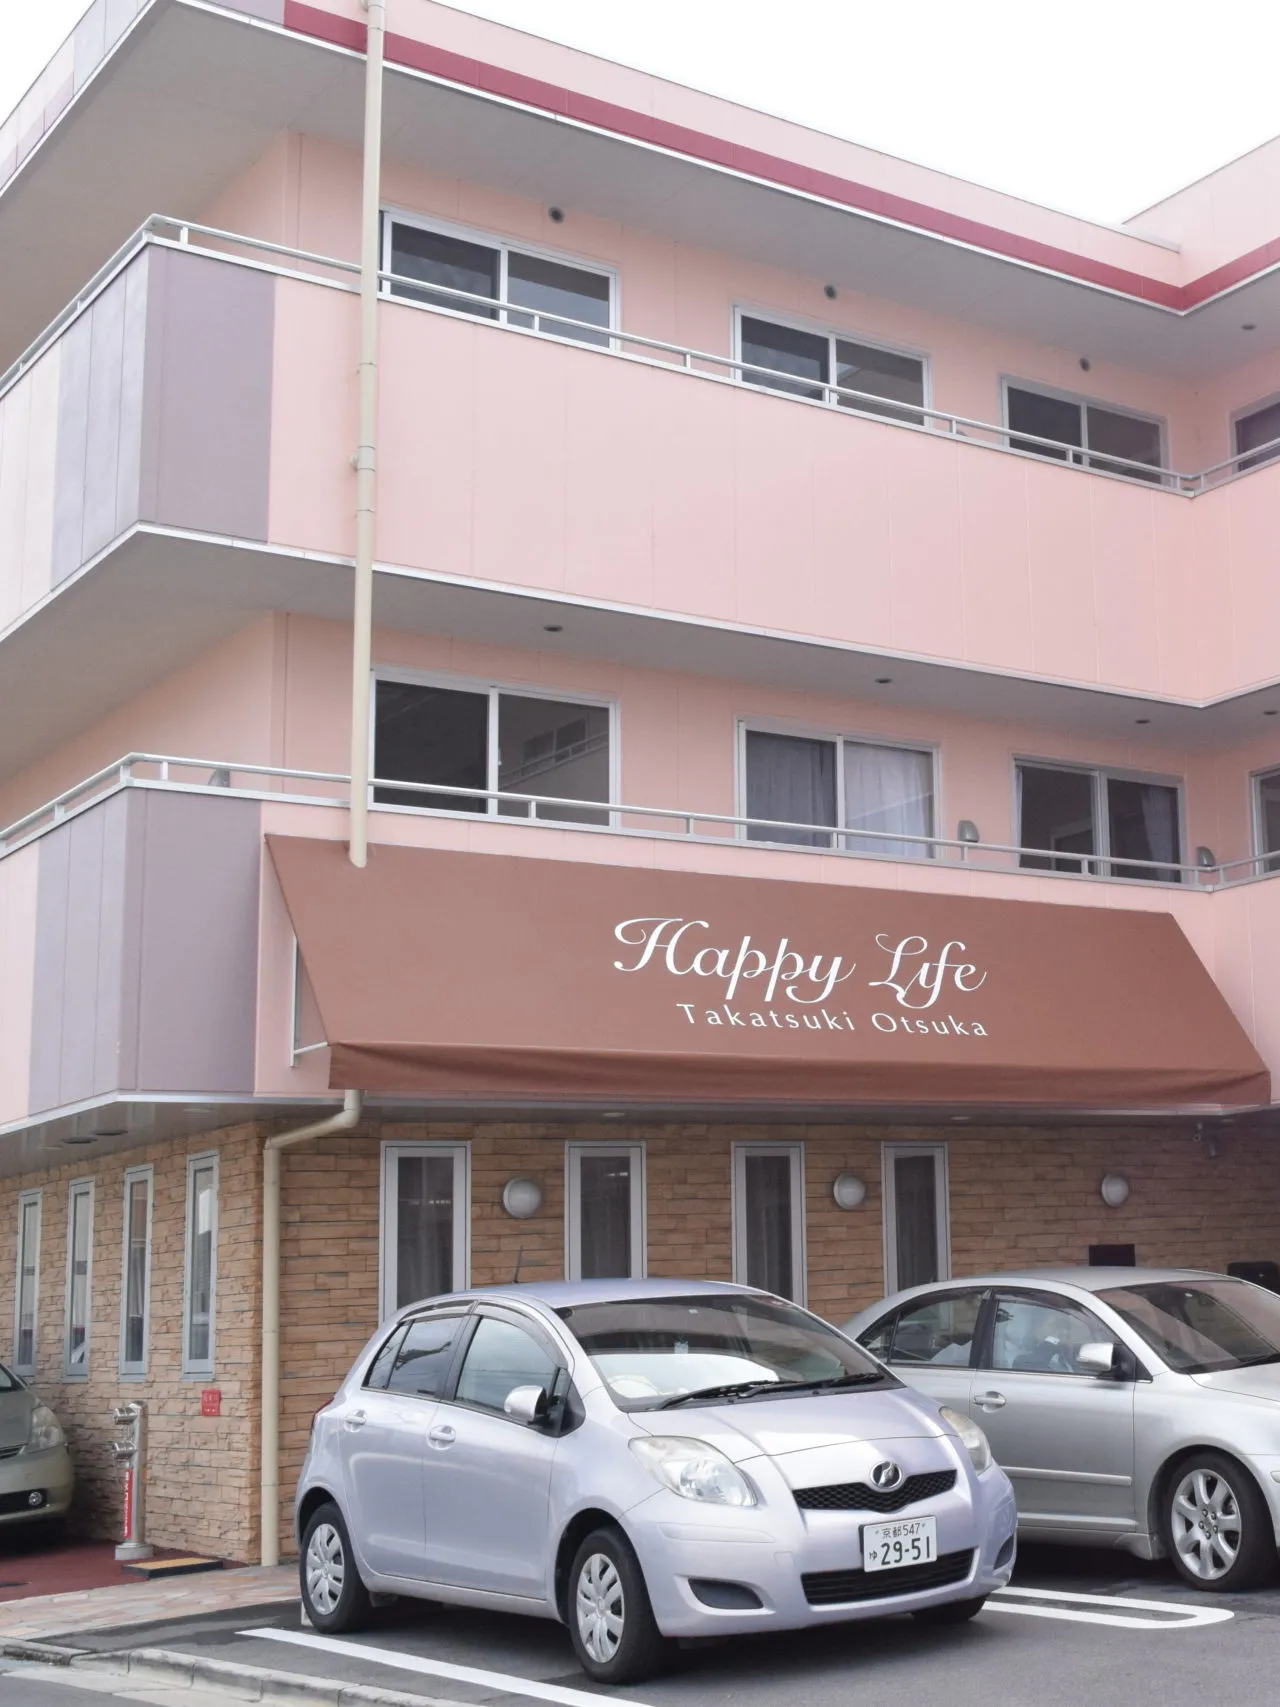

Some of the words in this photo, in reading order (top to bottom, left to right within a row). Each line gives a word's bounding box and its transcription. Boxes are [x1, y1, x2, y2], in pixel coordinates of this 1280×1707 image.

[613, 918, 856, 1004] Happy
[868, 933, 988, 1009] Life
[676, 1003, 855, 1031] Takatsuki
[871, 1012, 989, 1037] Otsuka
[881, 1536, 930, 1566] 29-51
